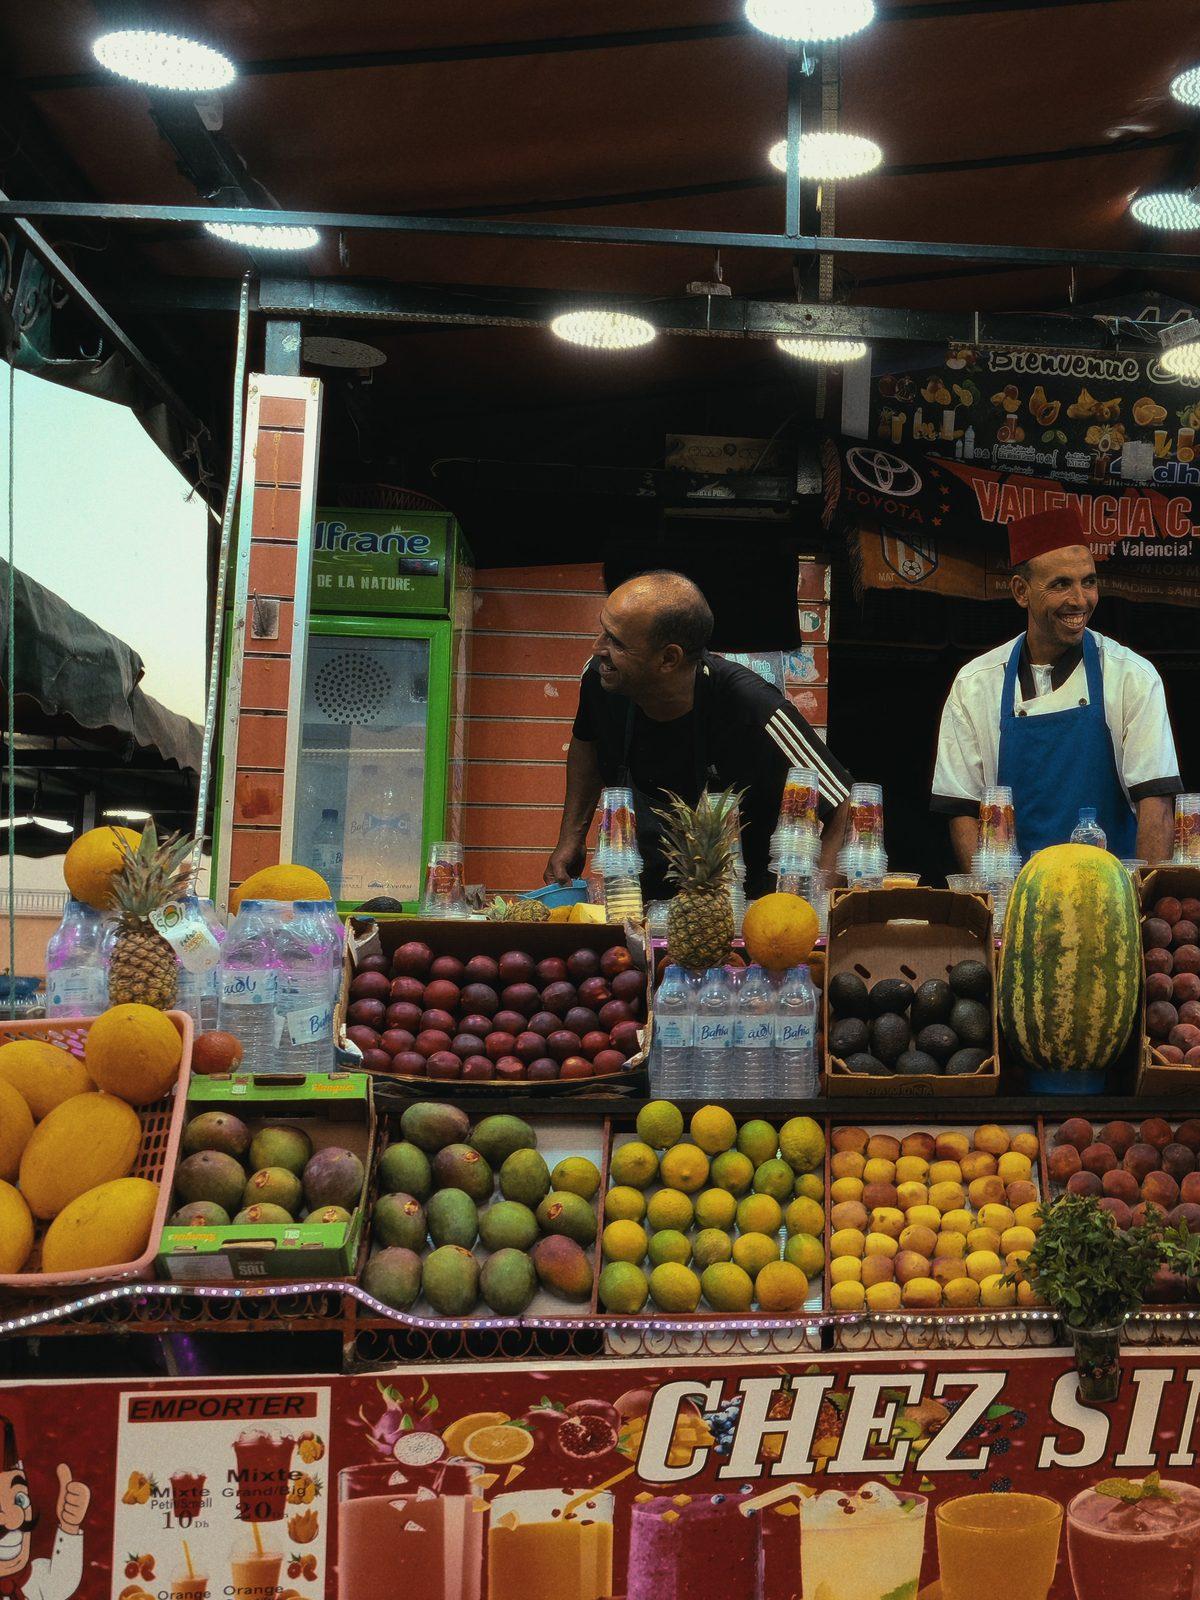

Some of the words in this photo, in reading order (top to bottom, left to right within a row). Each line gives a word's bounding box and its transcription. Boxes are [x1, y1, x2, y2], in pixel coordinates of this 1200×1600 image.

[988, 350, 1140, 384] Bienvenue
[846, 487, 923, 523] TOYOTA
[1119, 540, 1194, 558] Valencia!
[317, 674, 332, 689] DE
[338, 675, 355, 689] LA
[360, 677, 415, 692] NATURE.
[701, 1023, 729, 1040] Bahia
[783, 1023, 810, 1040] Bahia
[129, 1396, 305, 1420] EMPORTER
[635, 1371, 1008, 1481] CHEZ
[226, 1469, 302, 1483] Mixte
[151, 1487, 210, 1499] Mixte
[221, 1486, 307, 1500] Grand/Big
[234, 1502, 271, 1520] 20
[161, 1511, 193, 1530] 10
[158, 1590, 212, 1600] Orange
[222, 1585, 284, 1598] Orange
